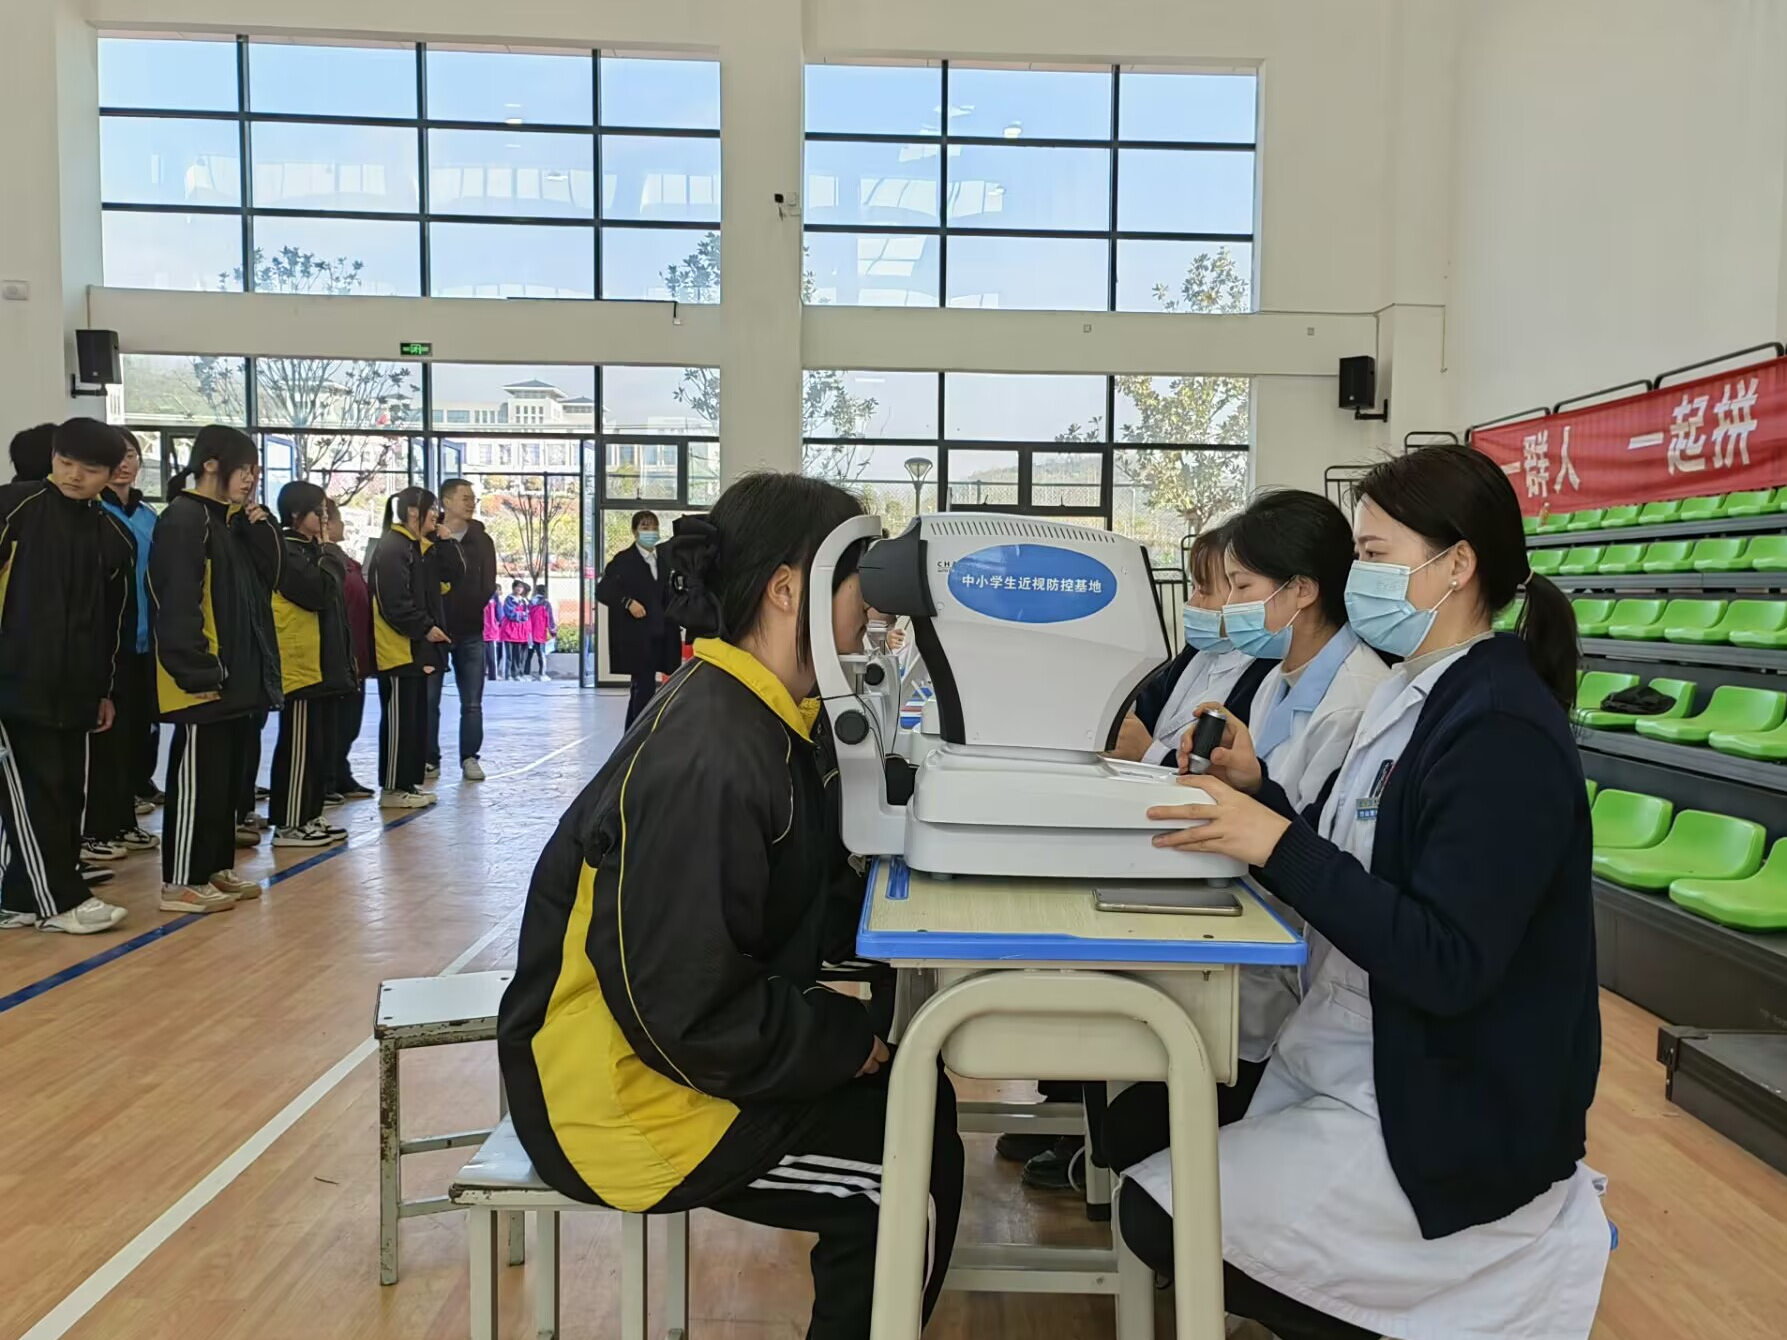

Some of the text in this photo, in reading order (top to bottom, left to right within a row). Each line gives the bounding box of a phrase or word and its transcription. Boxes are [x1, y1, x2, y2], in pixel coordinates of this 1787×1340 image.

[1500, 377, 1759, 498] 一群人 一起拼
[962, 574, 1102, 593] 中小学生近视防控基地
